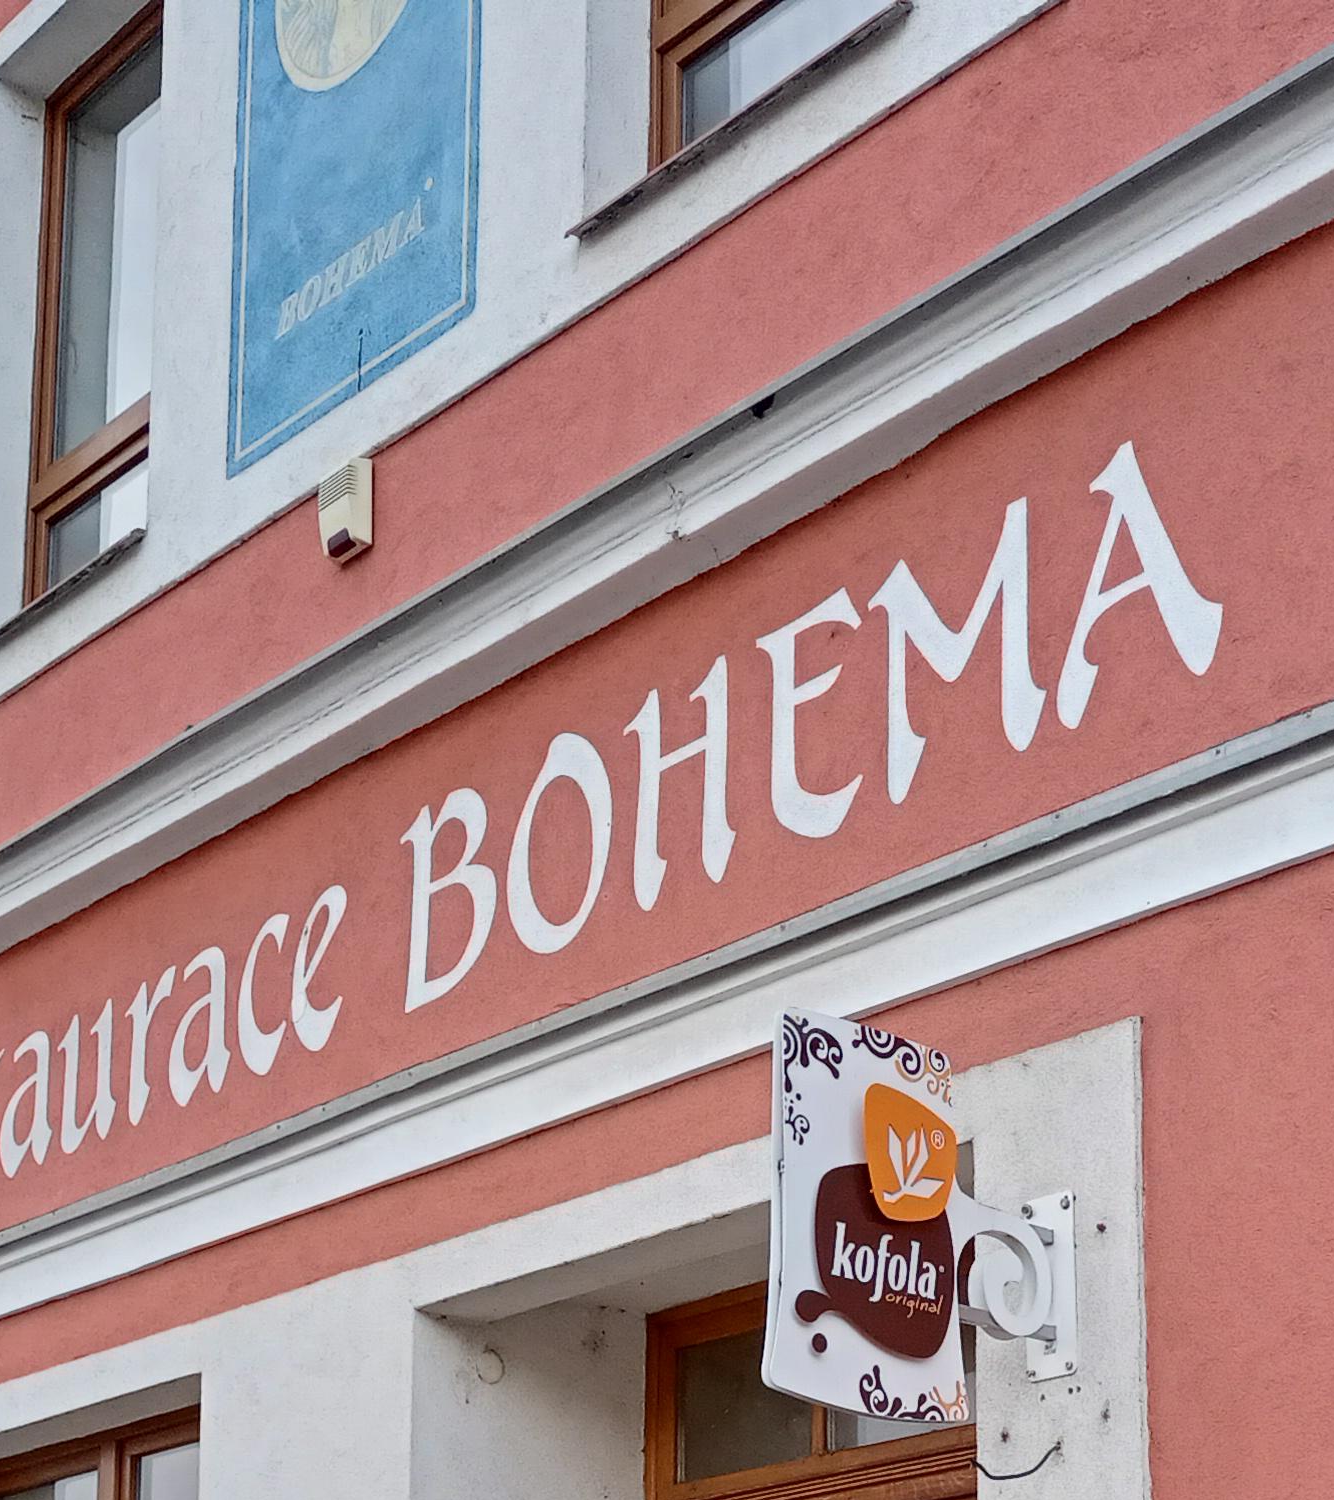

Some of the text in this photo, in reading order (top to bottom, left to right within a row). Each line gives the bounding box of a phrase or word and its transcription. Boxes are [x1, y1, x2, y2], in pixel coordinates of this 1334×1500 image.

[400, 440, 1224, 1014] BOHEMA
[831, 1221, 937, 1303] kofola
[885, 1293, 944, 1319] original
